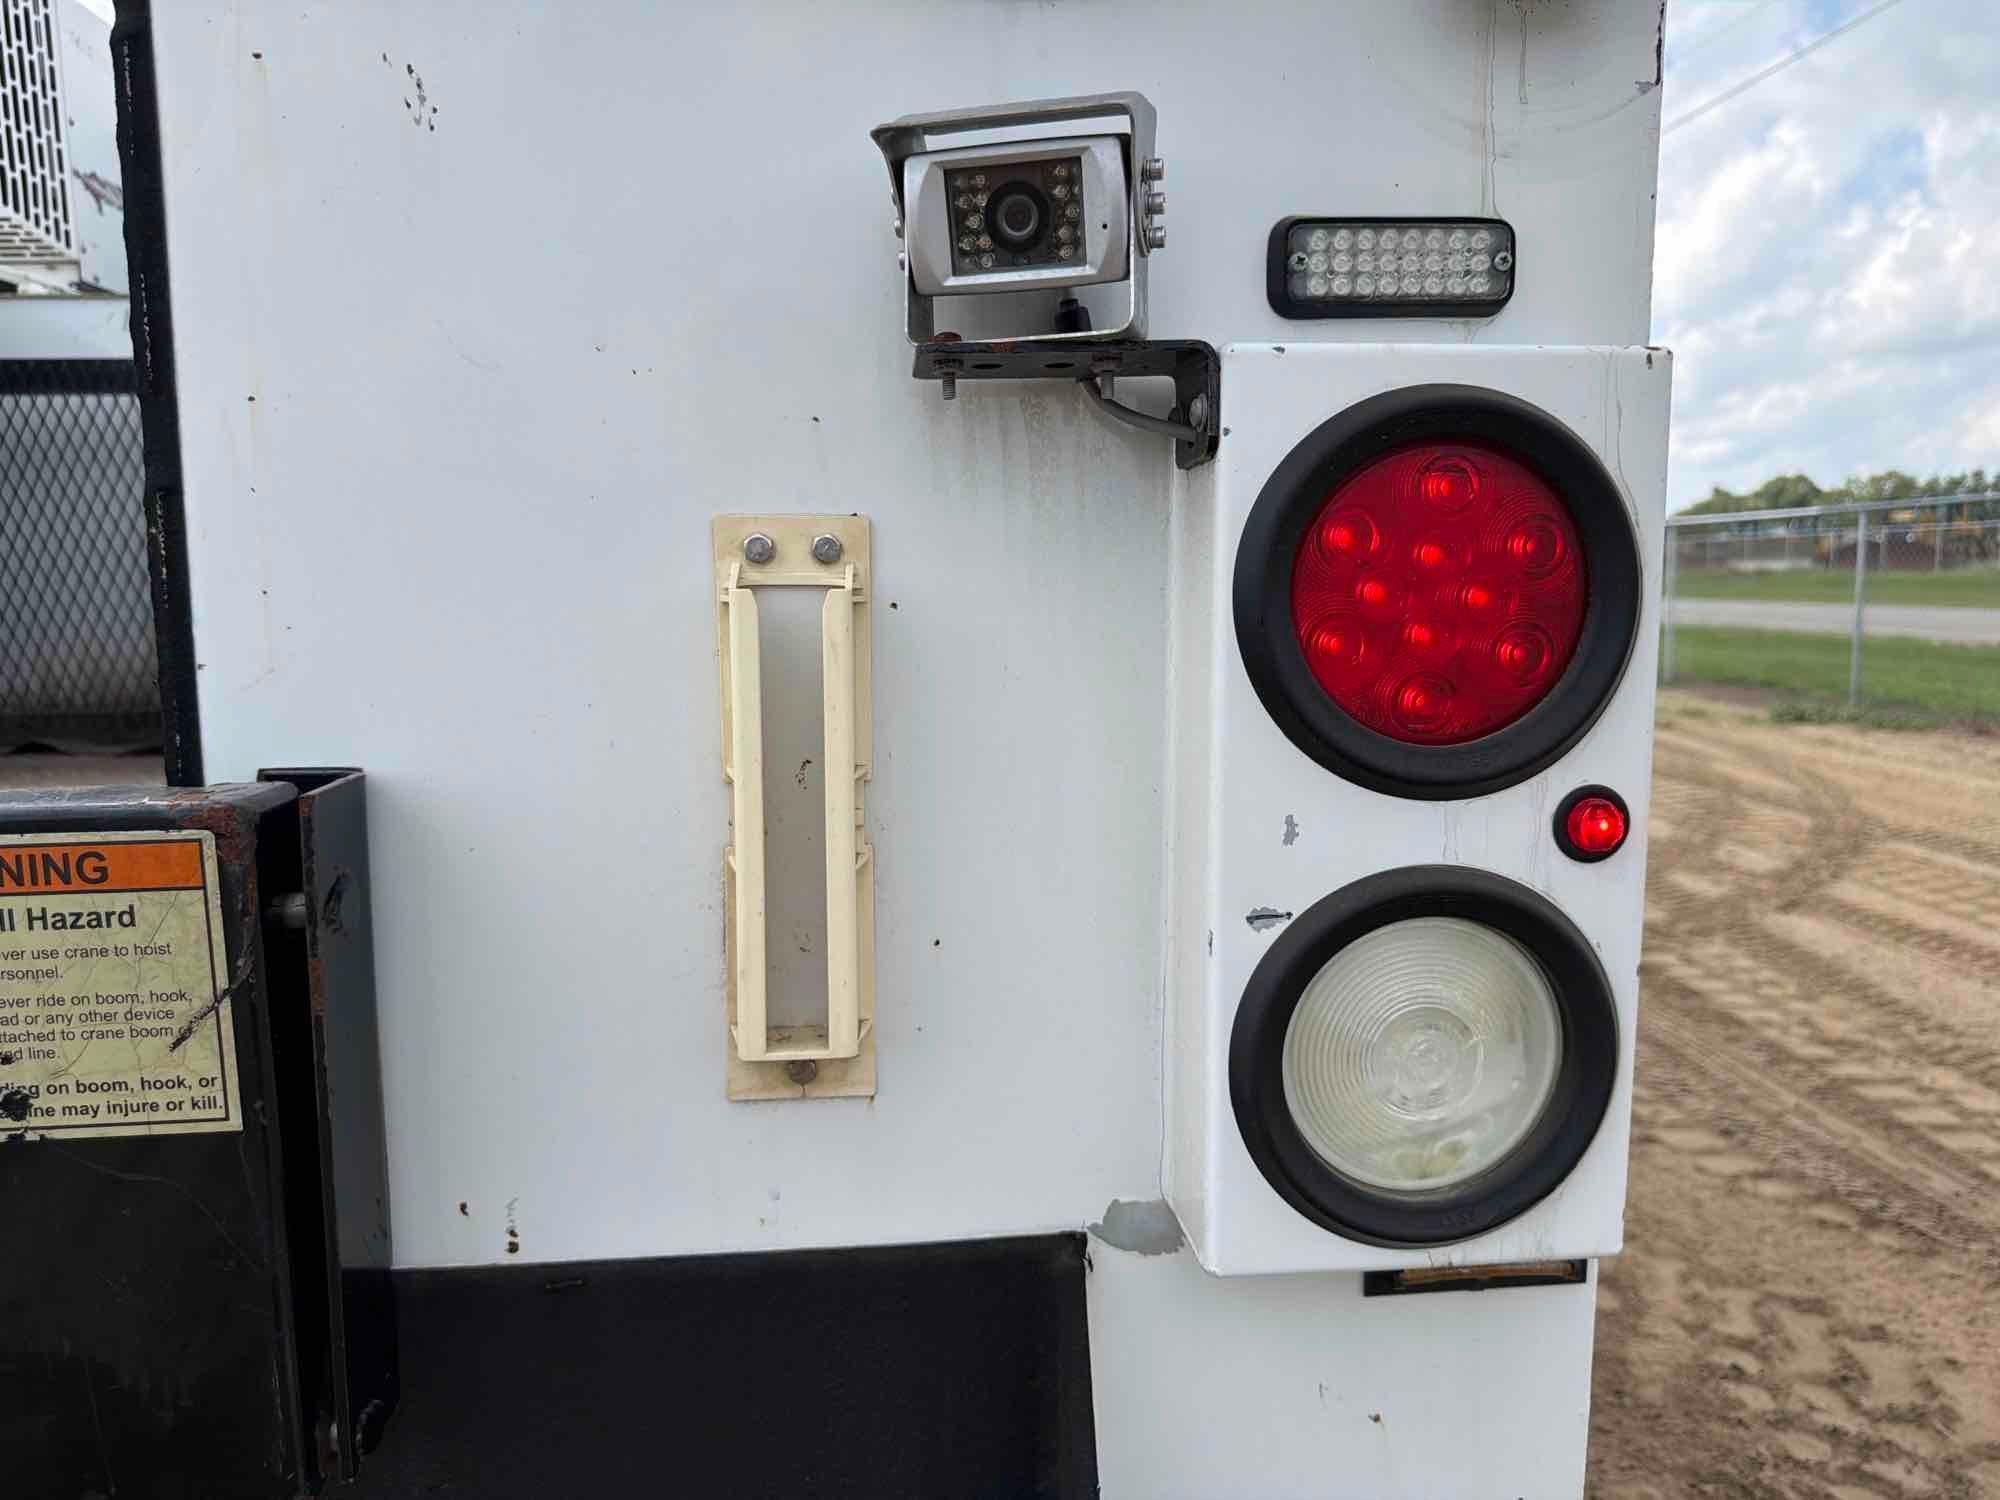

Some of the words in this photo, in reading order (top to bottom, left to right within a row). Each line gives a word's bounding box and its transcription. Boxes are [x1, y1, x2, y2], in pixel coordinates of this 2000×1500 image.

[27, 904, 136, 931] Hazard
[32, 948, 59, 960] use
[65, 946, 108, 959] crane
[114, 945, 129, 957] to
[134, 942, 172, 956] hoist
[37, 993, 65, 1007] ride
[71, 995, 90, 1006] on
[96, 991, 144, 1005] boom,
[150, 988, 192, 1004] hook,
[25, 1014, 40, 1026] or
[46, 1013, 73, 1026] any
[79, 1009, 118, 1023] other
[124, 1008, 175, 1021] device
[61, 1029, 75, 1041] to
[81, 1028, 125, 1041] crane
[129, 1025, 174, 1038] boom
[28, 1046, 60, 1060] line.
[46, 1083, 70, 1095] on
[76, 1079, 134, 1094] boom,
[141, 1075, 192, 1091] hook,
[199, 1076, 217, 1088] or
[62, 1104, 100, 1118] may
[106, 1099, 160, 1117] injure
[166, 1100, 184, 1112] or
[191, 1095, 223, 1111] kill.
